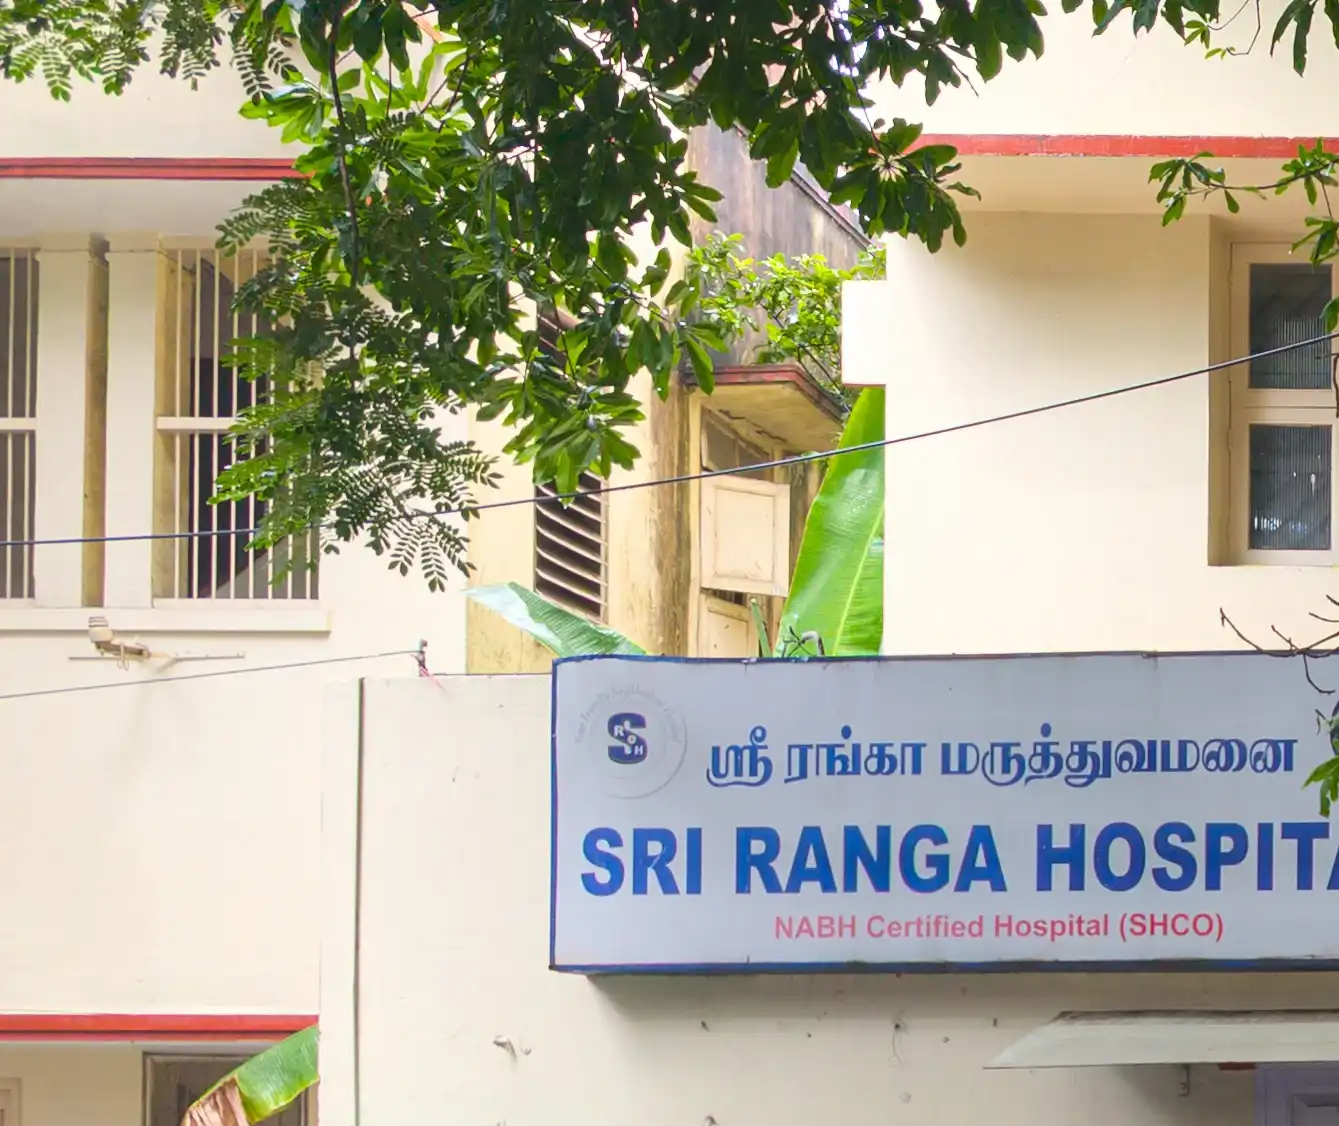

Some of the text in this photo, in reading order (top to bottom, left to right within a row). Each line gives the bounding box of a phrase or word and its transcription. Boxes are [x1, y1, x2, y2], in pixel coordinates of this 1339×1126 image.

[785, 725, 926, 786] ரங்கா
[938, 723, 1299, 789] மருத்துவமனை
[581, 825, 703, 898] SRI
[736, 822, 1009, 895] RANGA
[774, 912, 1225, 943] NABH Certified Hospital (SHCO)
